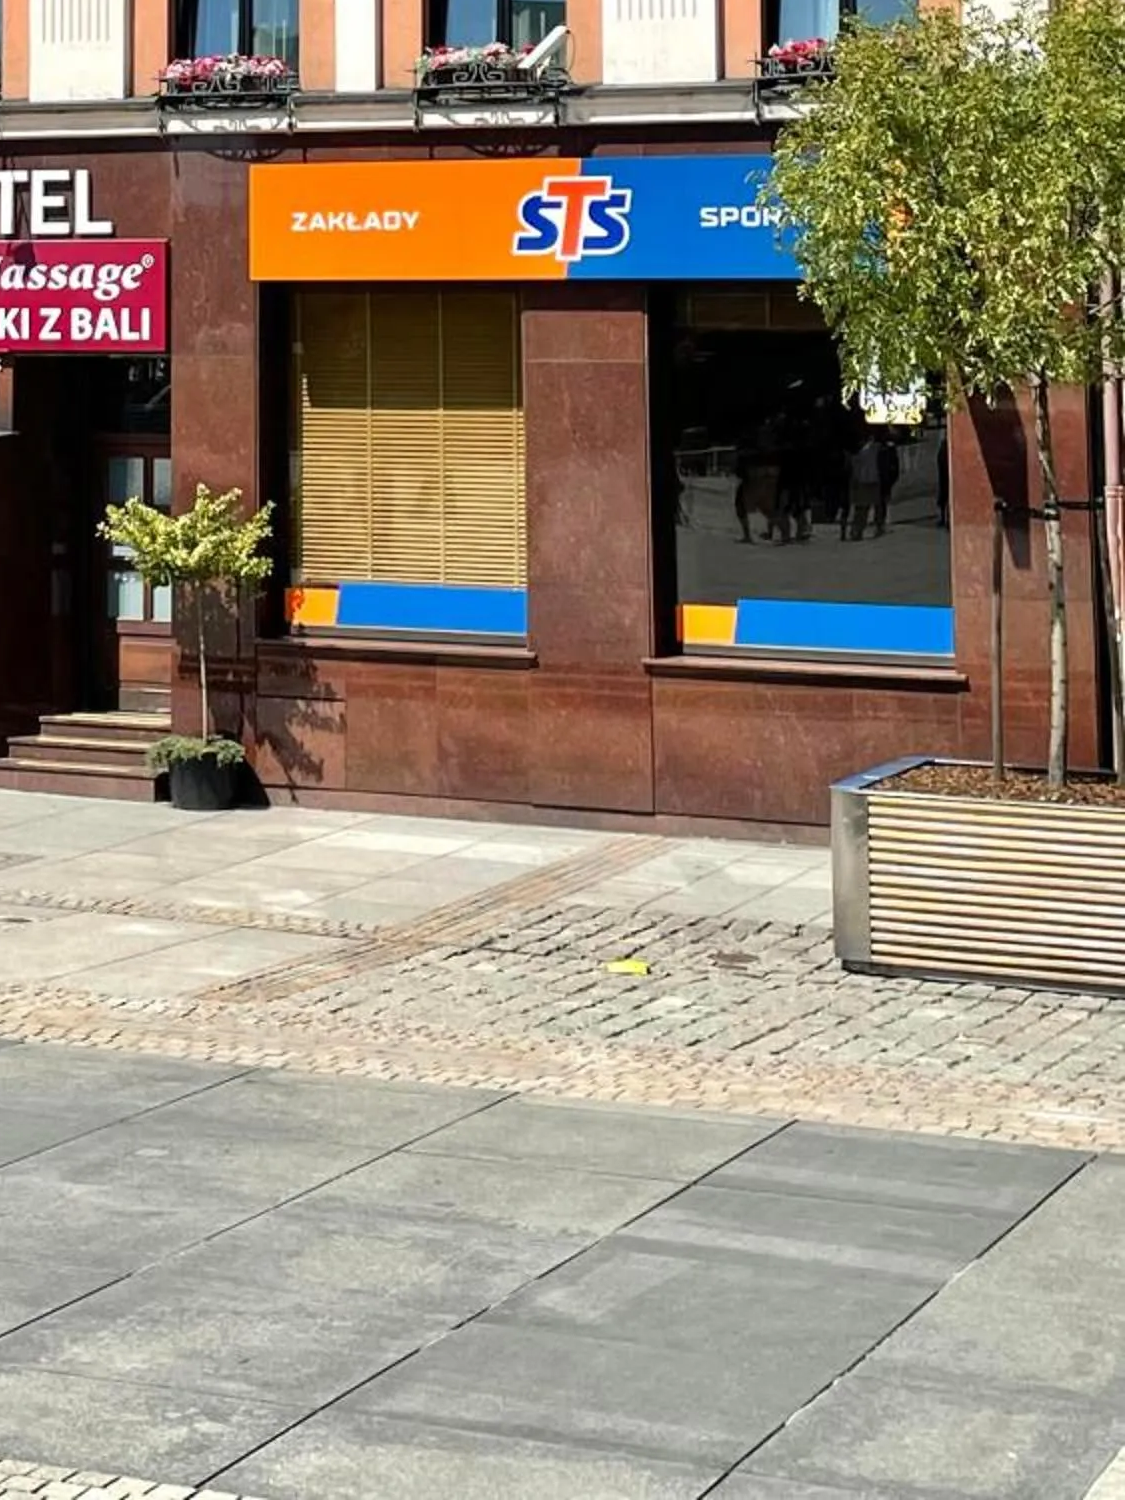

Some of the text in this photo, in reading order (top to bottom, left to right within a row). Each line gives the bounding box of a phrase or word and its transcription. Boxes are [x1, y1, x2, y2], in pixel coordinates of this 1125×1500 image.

[291, 211, 419, 232] ZAKŁADY
[513, 175, 632, 261] STS
[38, 307, 61, 340] Z
[70, 307, 150, 341] BALI
